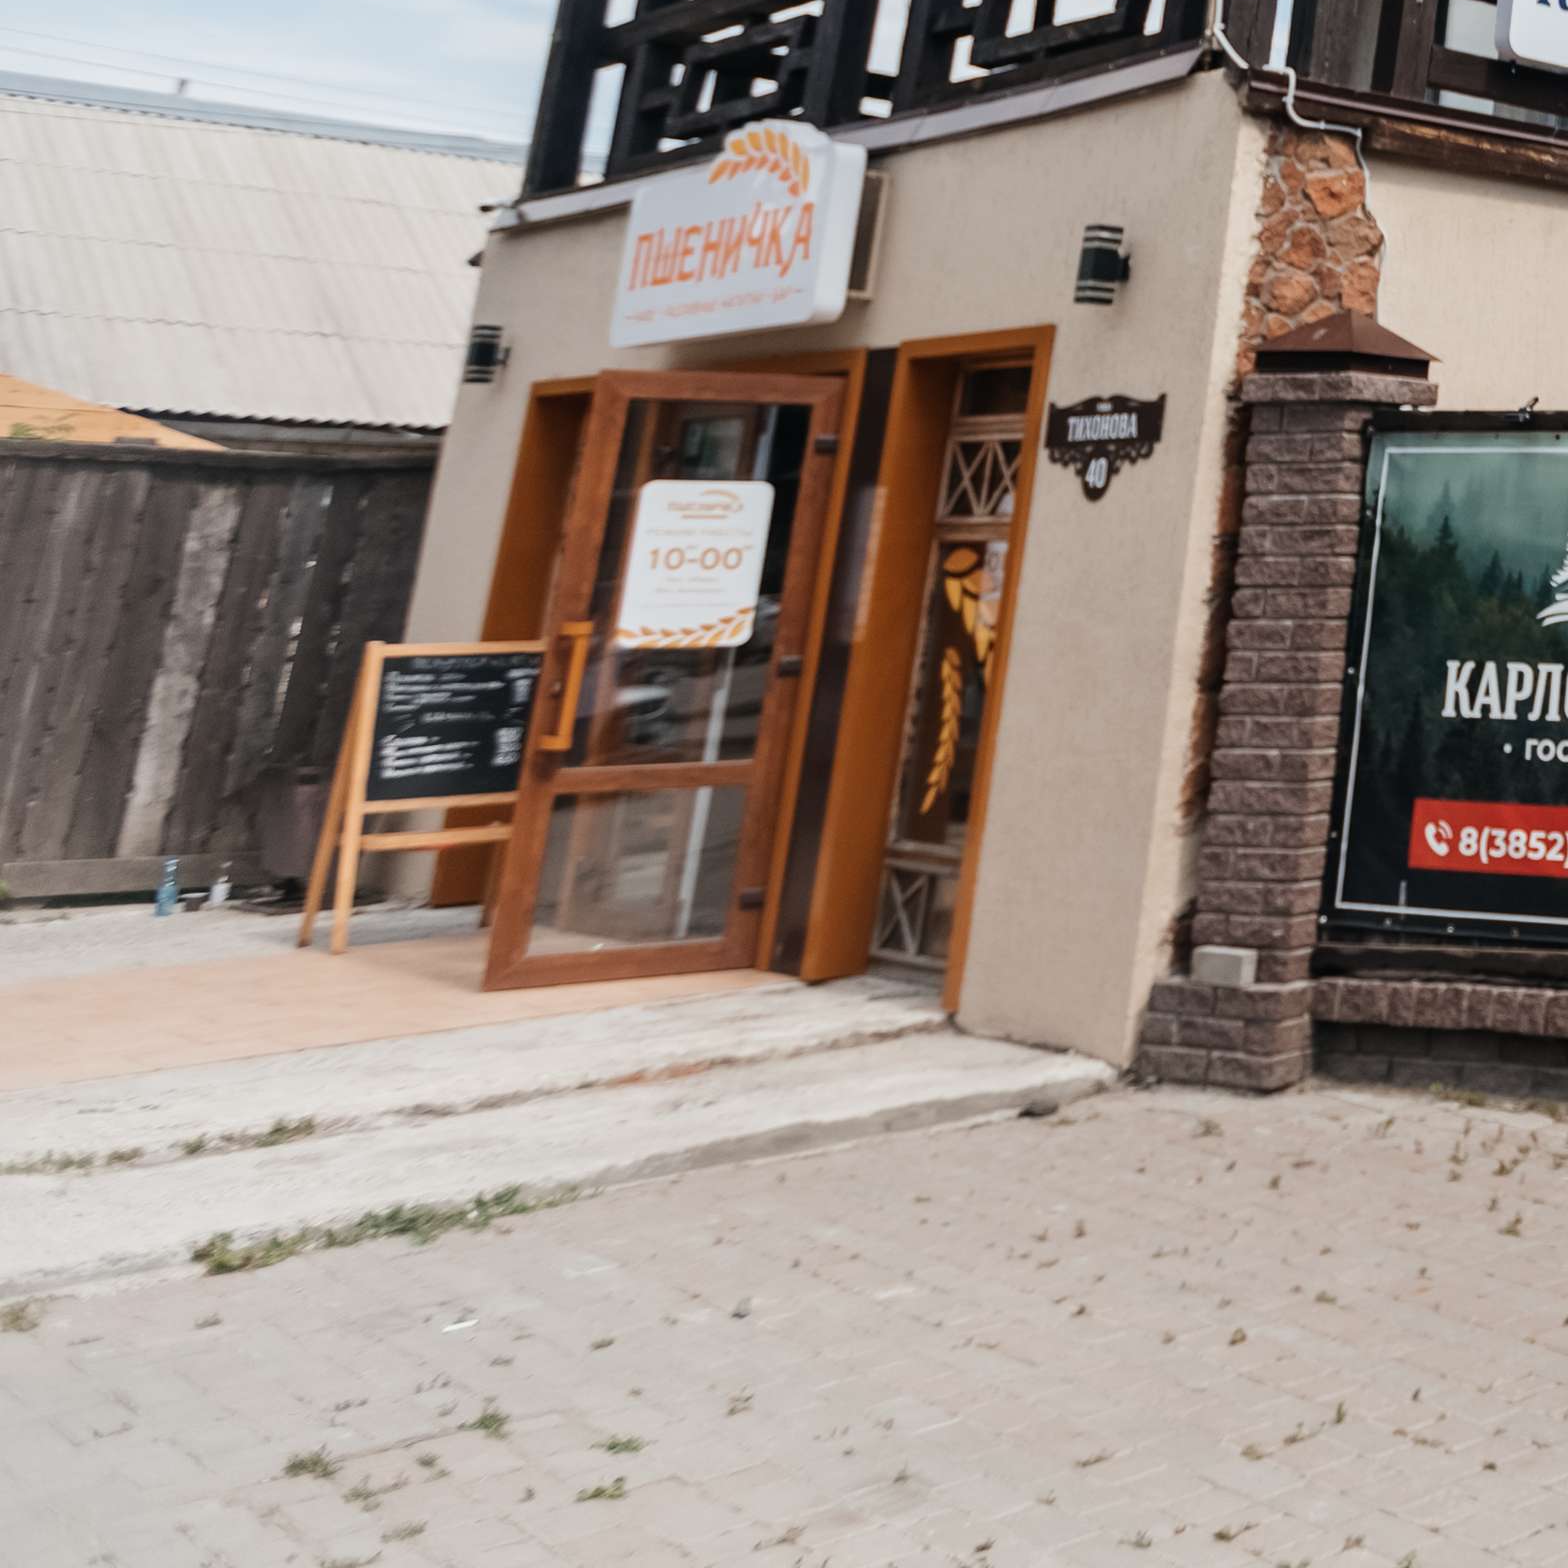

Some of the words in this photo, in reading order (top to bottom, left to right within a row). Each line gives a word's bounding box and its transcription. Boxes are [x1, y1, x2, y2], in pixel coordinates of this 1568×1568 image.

[628, 201, 815, 291] ПШЕНИЧКА
[1067, 412, 1138, 442] ТИХОНОВА
[1085, 457, 1109, 489] 40
